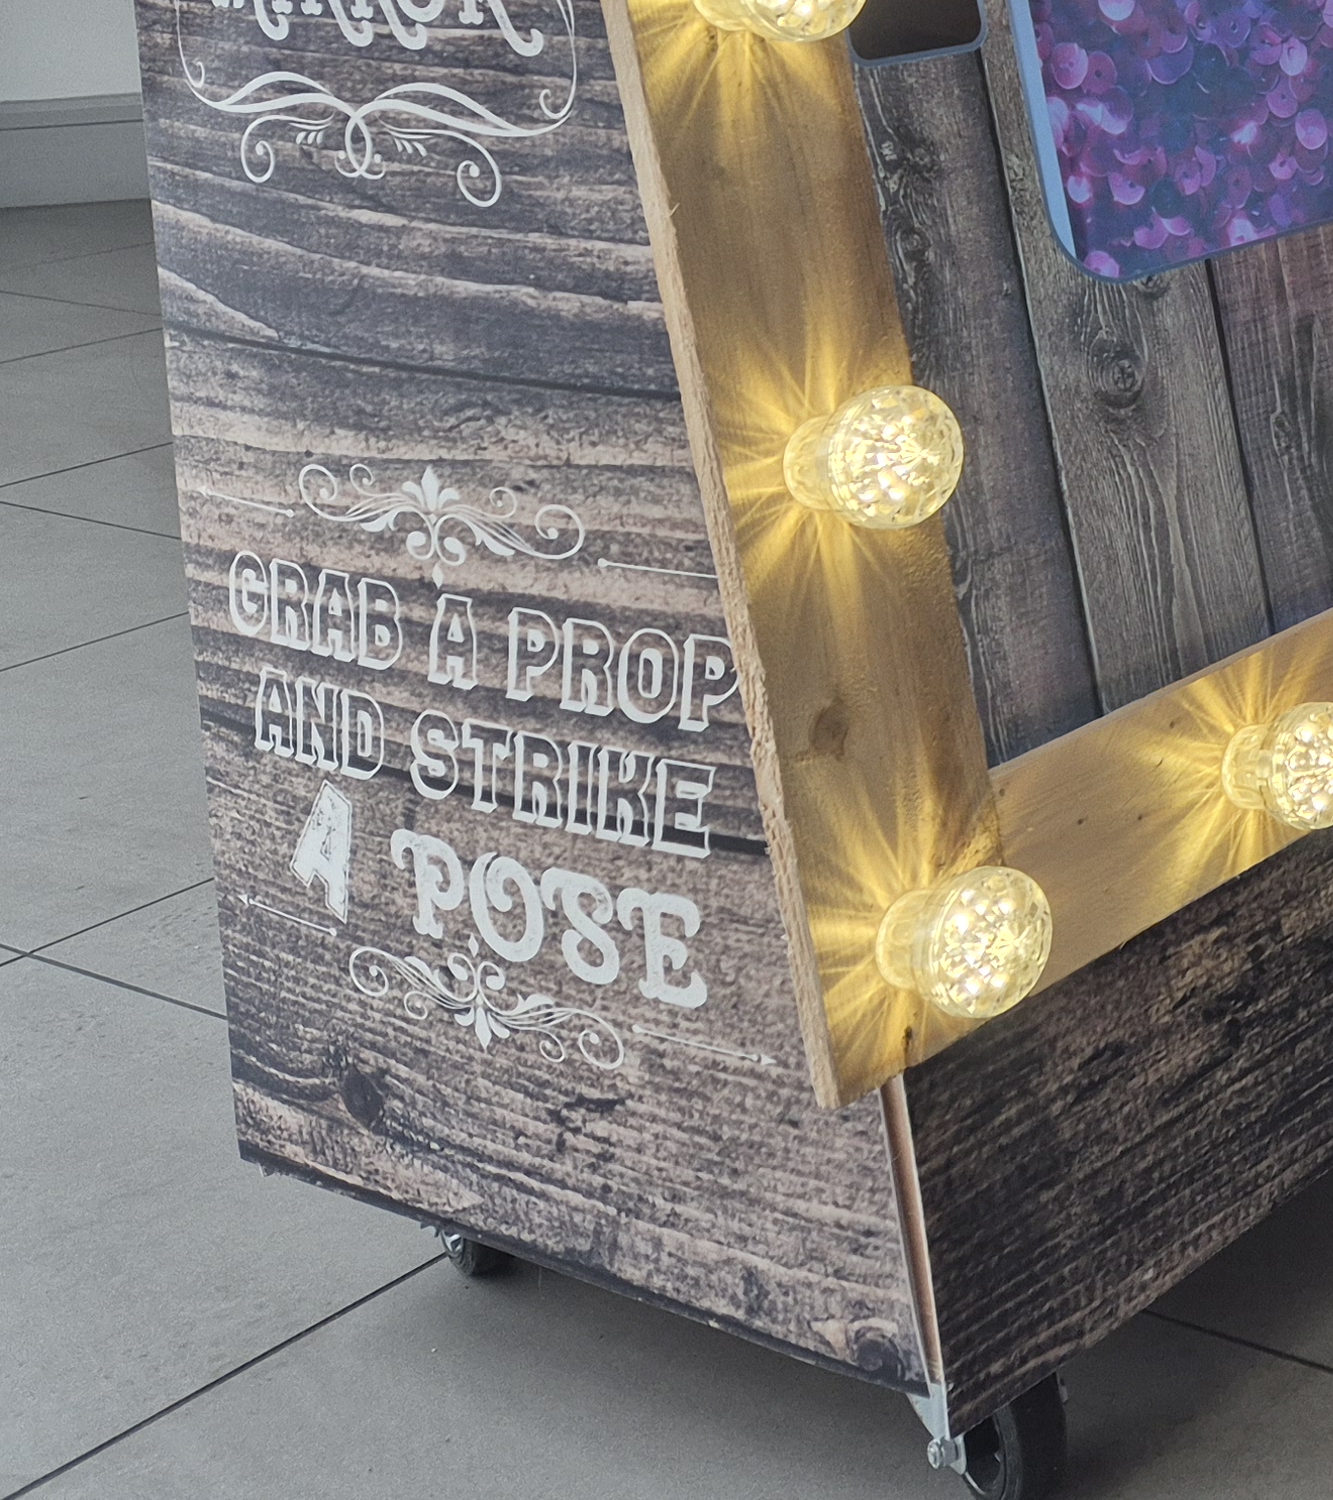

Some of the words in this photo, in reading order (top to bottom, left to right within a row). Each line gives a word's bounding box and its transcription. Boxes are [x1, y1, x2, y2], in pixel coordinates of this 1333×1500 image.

[228, 550, 403, 671] GRAB
[427, 592, 479, 690] A
[504, 606, 740, 733] PROP
[254, 667, 385, 781] AND
[409, 709, 717, 859] STRIKE
[289, 779, 353, 924] A
[390, 827, 709, 1009] POSE
